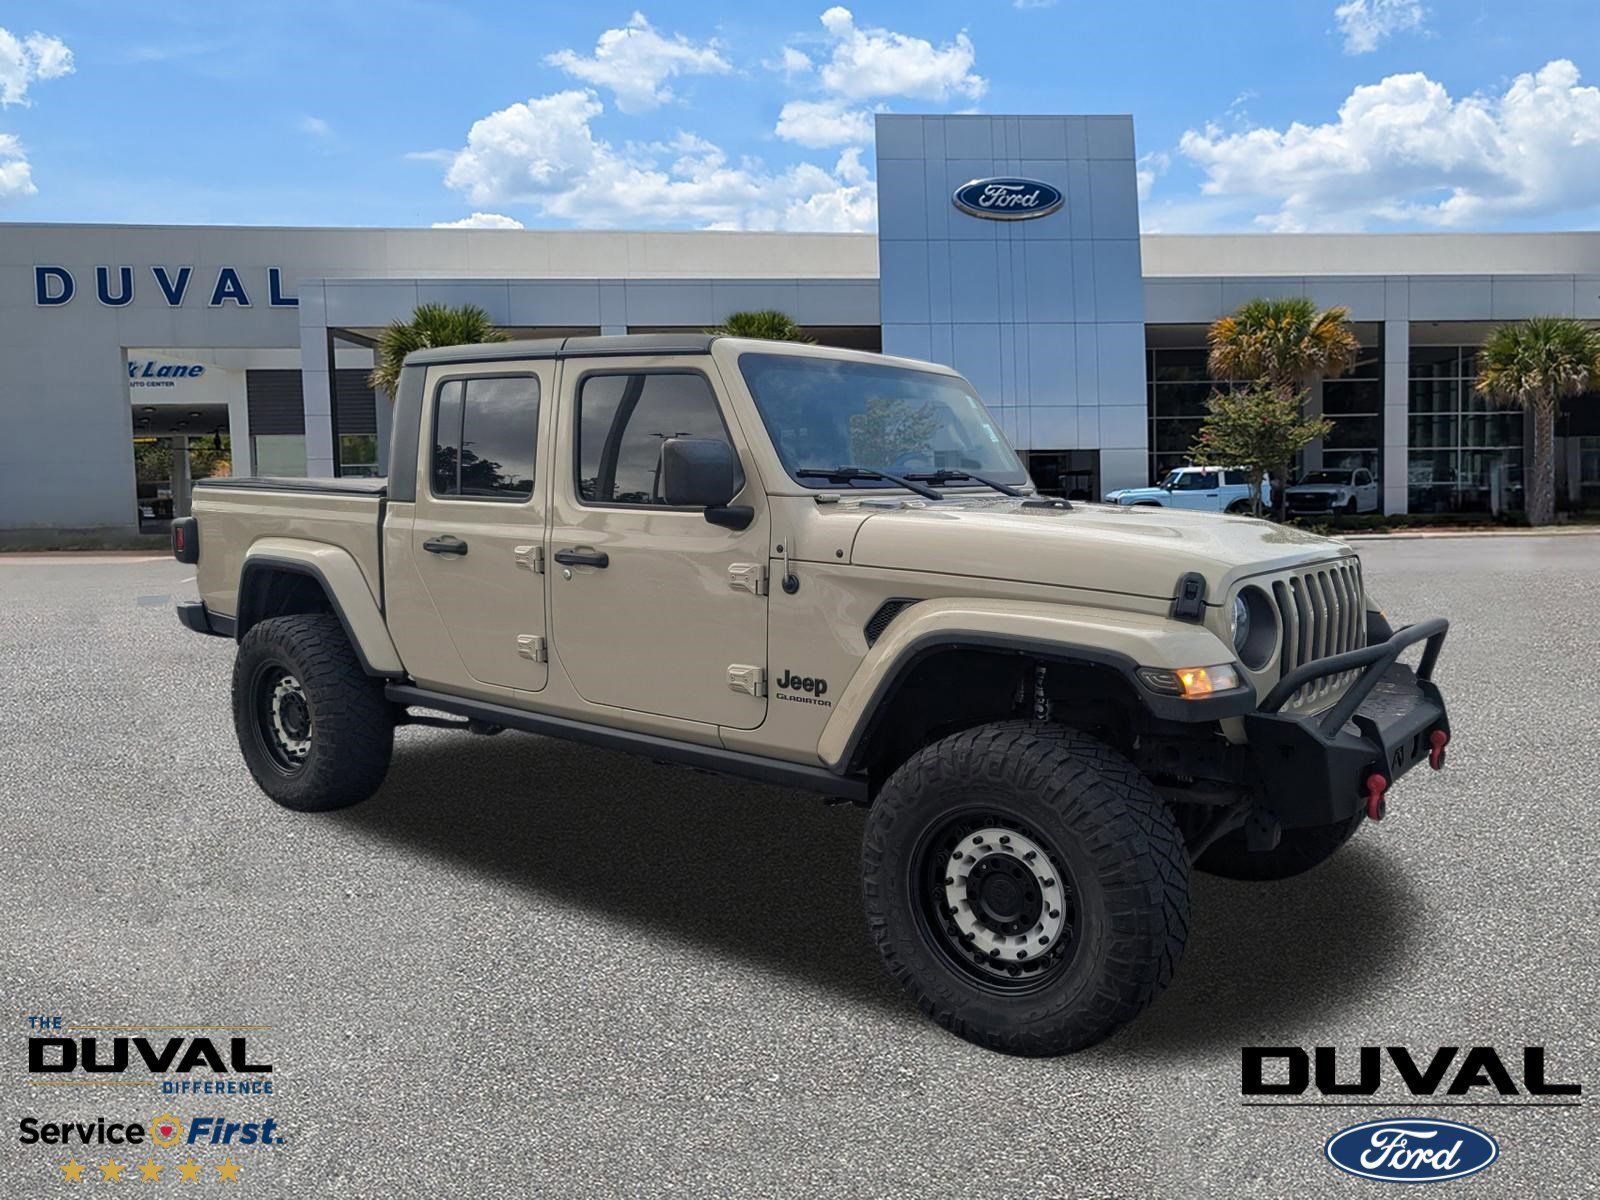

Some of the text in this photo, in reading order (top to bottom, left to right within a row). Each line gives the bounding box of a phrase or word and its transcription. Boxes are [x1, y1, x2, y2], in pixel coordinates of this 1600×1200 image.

[978, 184, 1041, 208] Ford
[33, 265, 299, 307] DUVAL
[141, 361, 206, 378] Lane
[776, 669, 828, 697] Jeep
[776, 693, 832, 707] GLADIATOR
